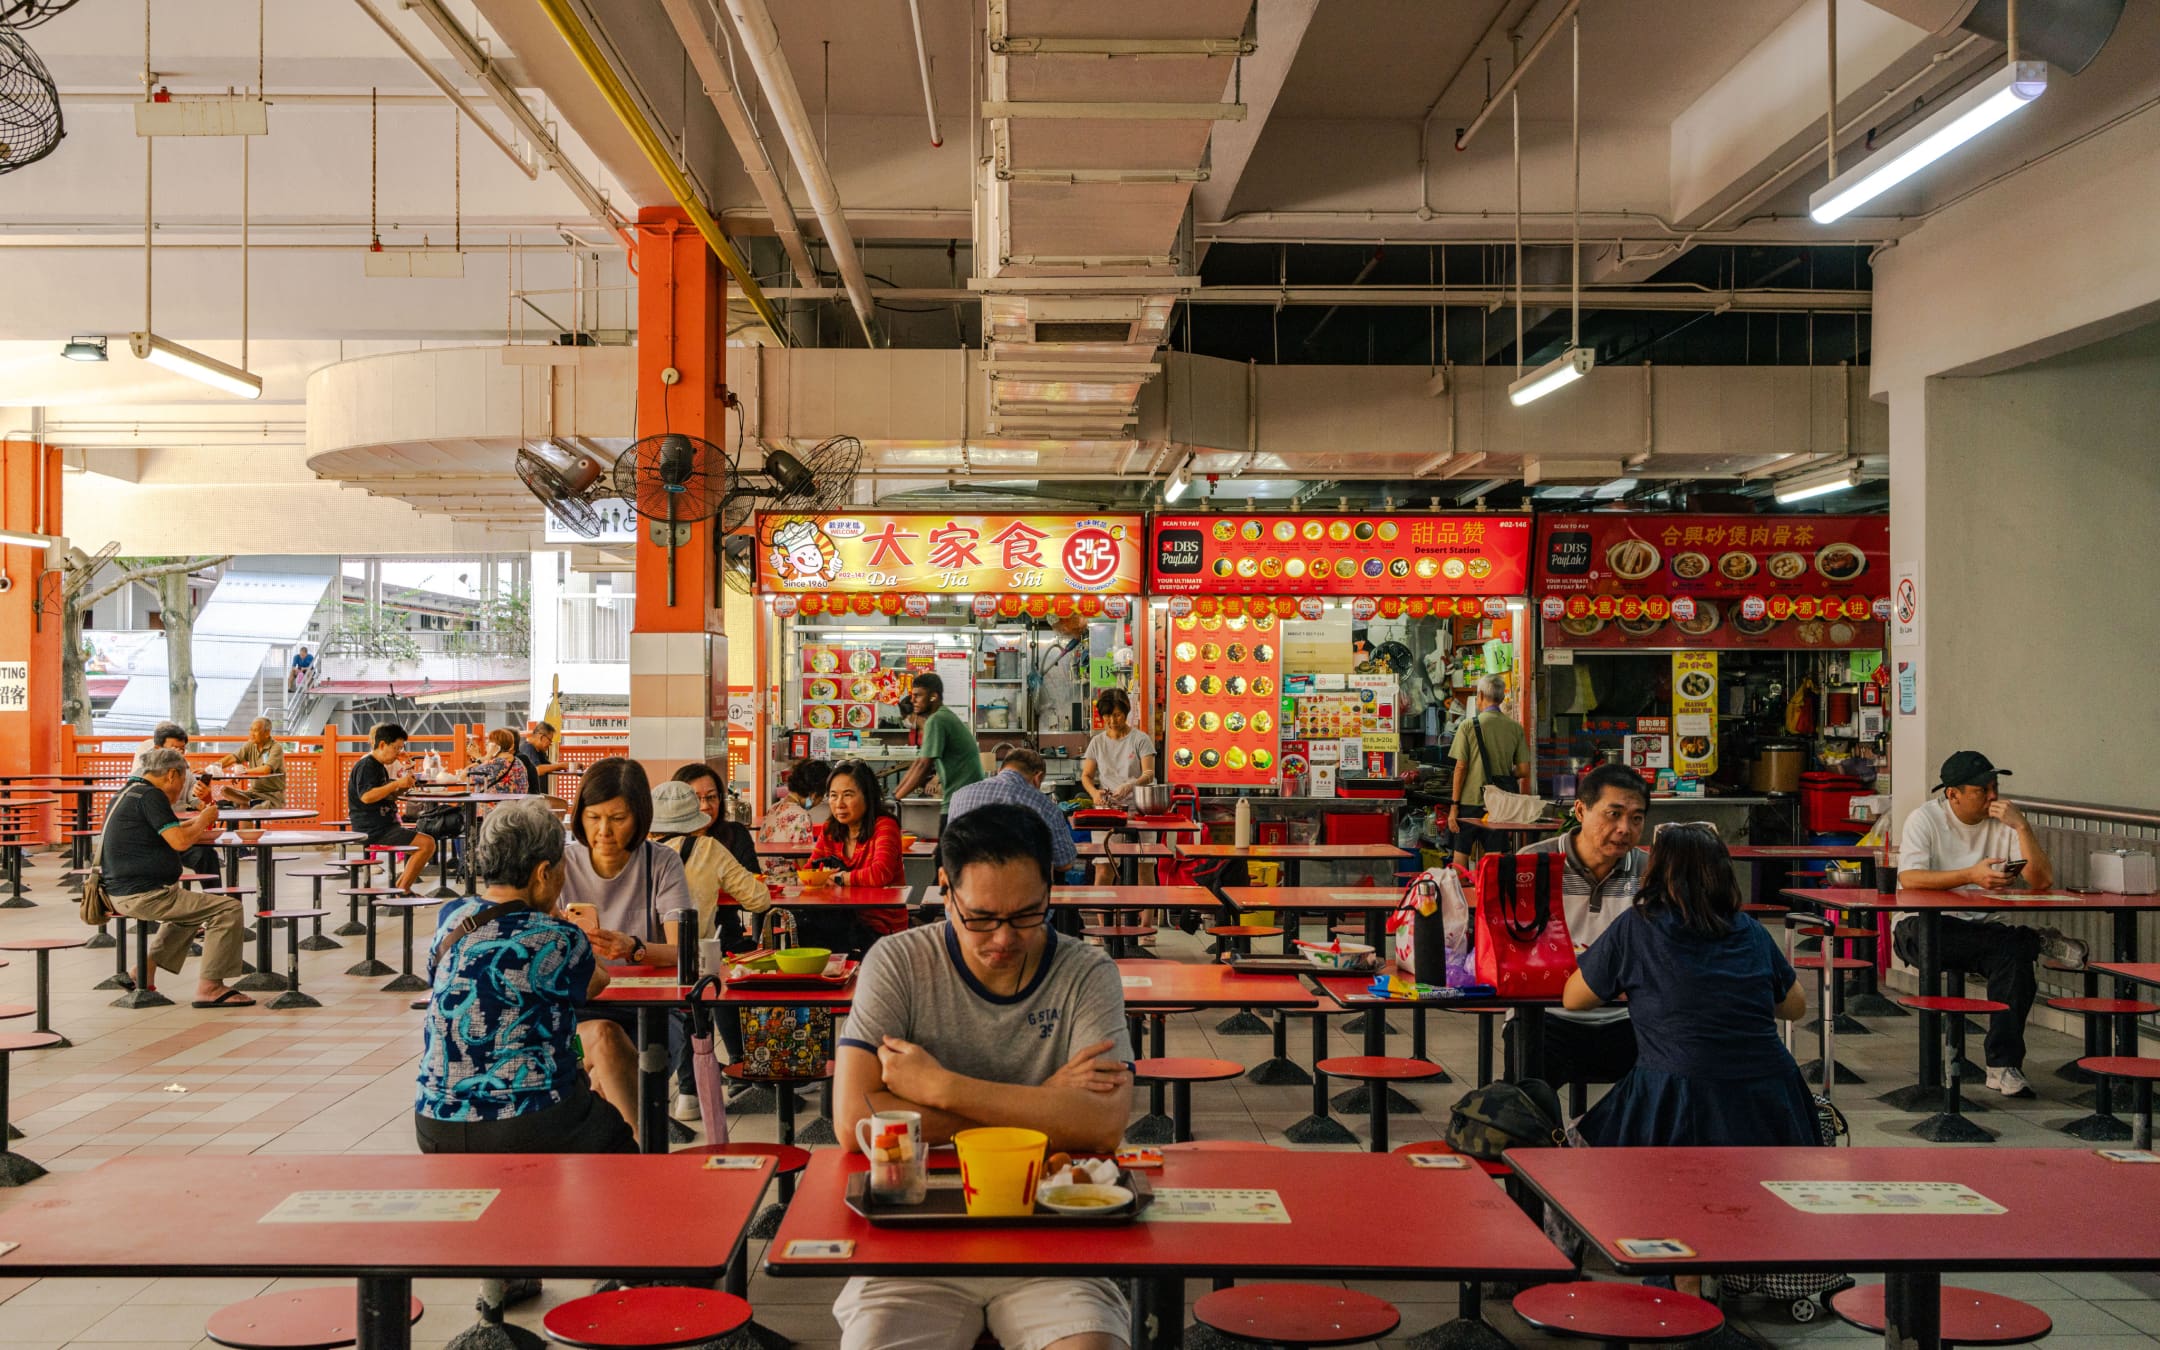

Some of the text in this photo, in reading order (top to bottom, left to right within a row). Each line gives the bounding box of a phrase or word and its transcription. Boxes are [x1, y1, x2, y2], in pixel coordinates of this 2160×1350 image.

[1411, 521, 1486, 545] 甜品赞
[1661, 524, 1815, 547] 合興砂煲肉骨茶
[862, 521, 1050, 570] 大家食
[1174, 541, 1199, 552] DBS
[1563, 543, 1587, 553] DBS
[1162, 552, 1198, 566] PayLah!
[1551, 554, 1586, 567] PayLah!
[783, 579, 828, 588] Since 1960
[866, 570, 1043, 588] Da Jia Shi
[1384, 601, 1474, 613] 财源广进
[1573, 601, 1663, 615] 恭喜发财
[1773, 601, 1865, 615] 财源广进
[0, 667, 26, 679] TING
